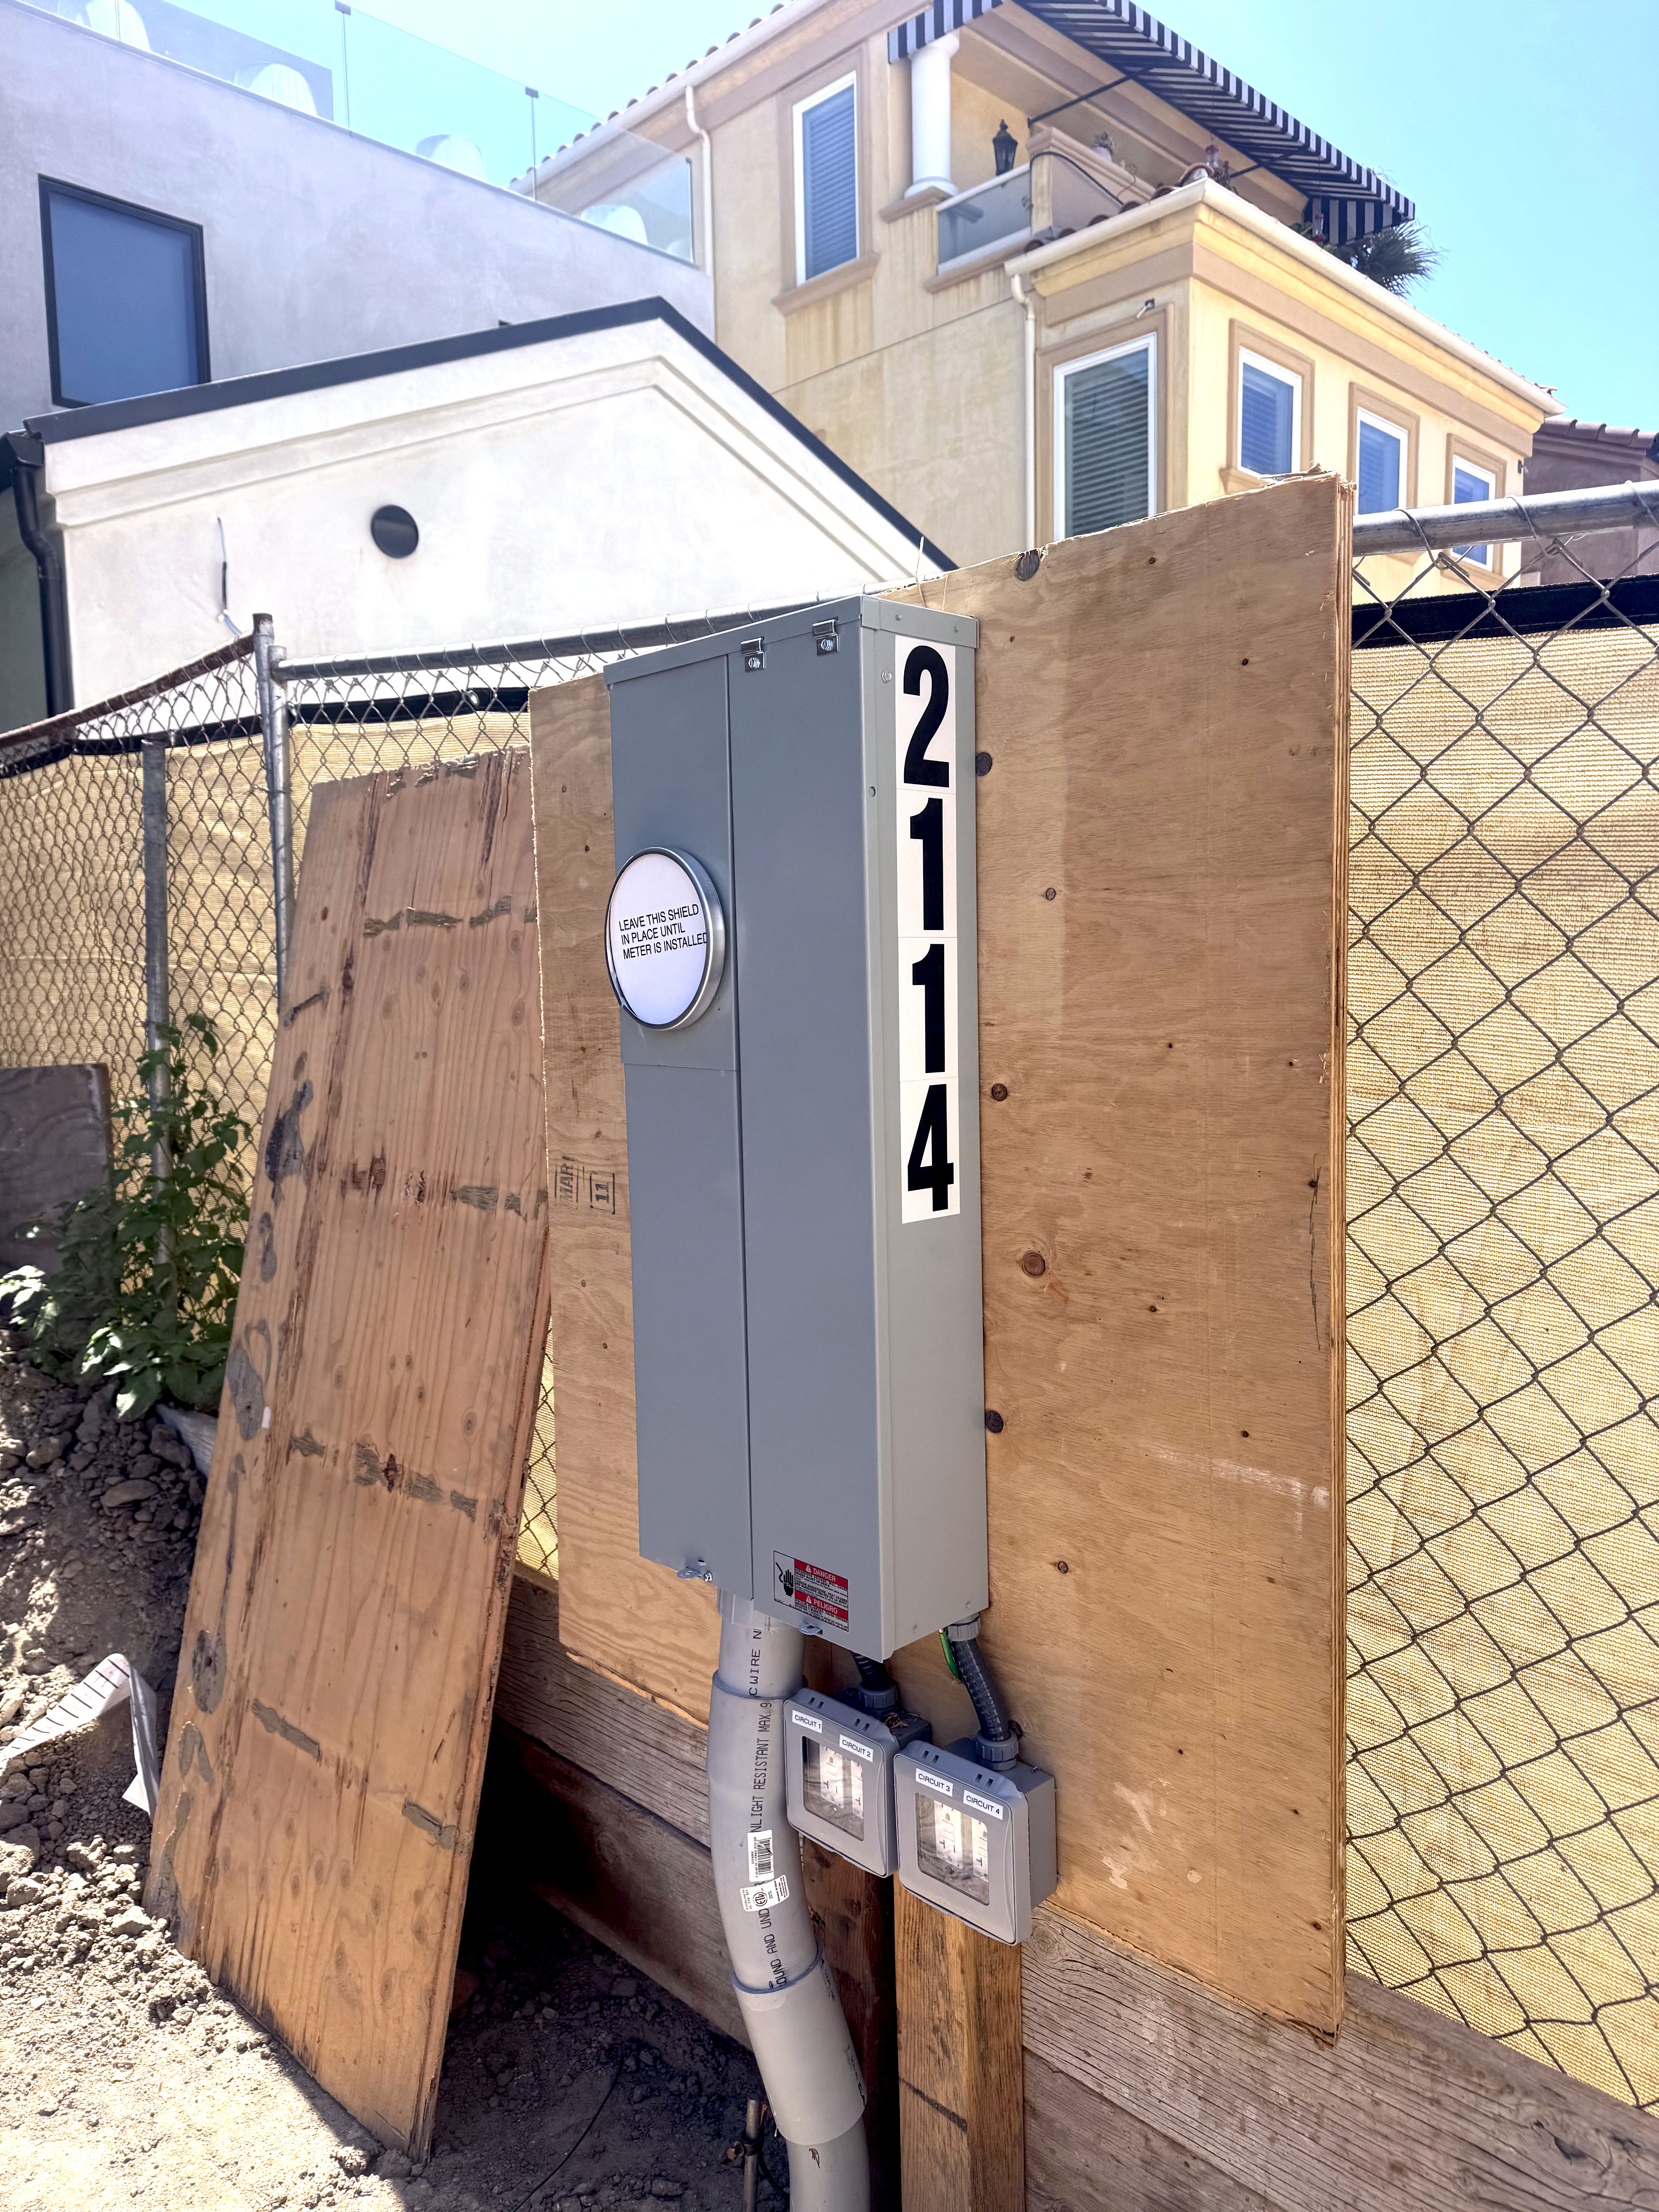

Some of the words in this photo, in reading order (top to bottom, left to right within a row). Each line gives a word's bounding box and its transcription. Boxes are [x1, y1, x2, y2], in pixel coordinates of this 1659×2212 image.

[619, 916, 645, 931] LEAVE
[646, 911, 666, 925] THIS
[668, 904, 699, 921] SHIELD
[621, 934, 630, 945] IN
[631, 927, 659, 943] PLACE
[660, 922, 685, 937] UNTIL
[903, 645, 954, 1211] 2114
[623, 944, 652, 960] METER
[654, 942, 661, 953] IS
[813, 1568, 836, 1582] DANGER
[814, 1598, 837, 1614] PELIGRO
[753, 1629, 762, 1639] N
[758, 1715, 771, 1732] MAX
[795, 1715, 817, 1727] CIRCUIT
[842, 1740, 866, 1755] CIRCUIT
[753, 1738, 769, 1790] RESISTANT
[918, 1774, 945, 1789] CIRCUIT
[966, 1795, 994, 1812] CIRCUIT
[764, 1934, 778, 1954] AND
[770, 1959, 786, 1985] OUND
